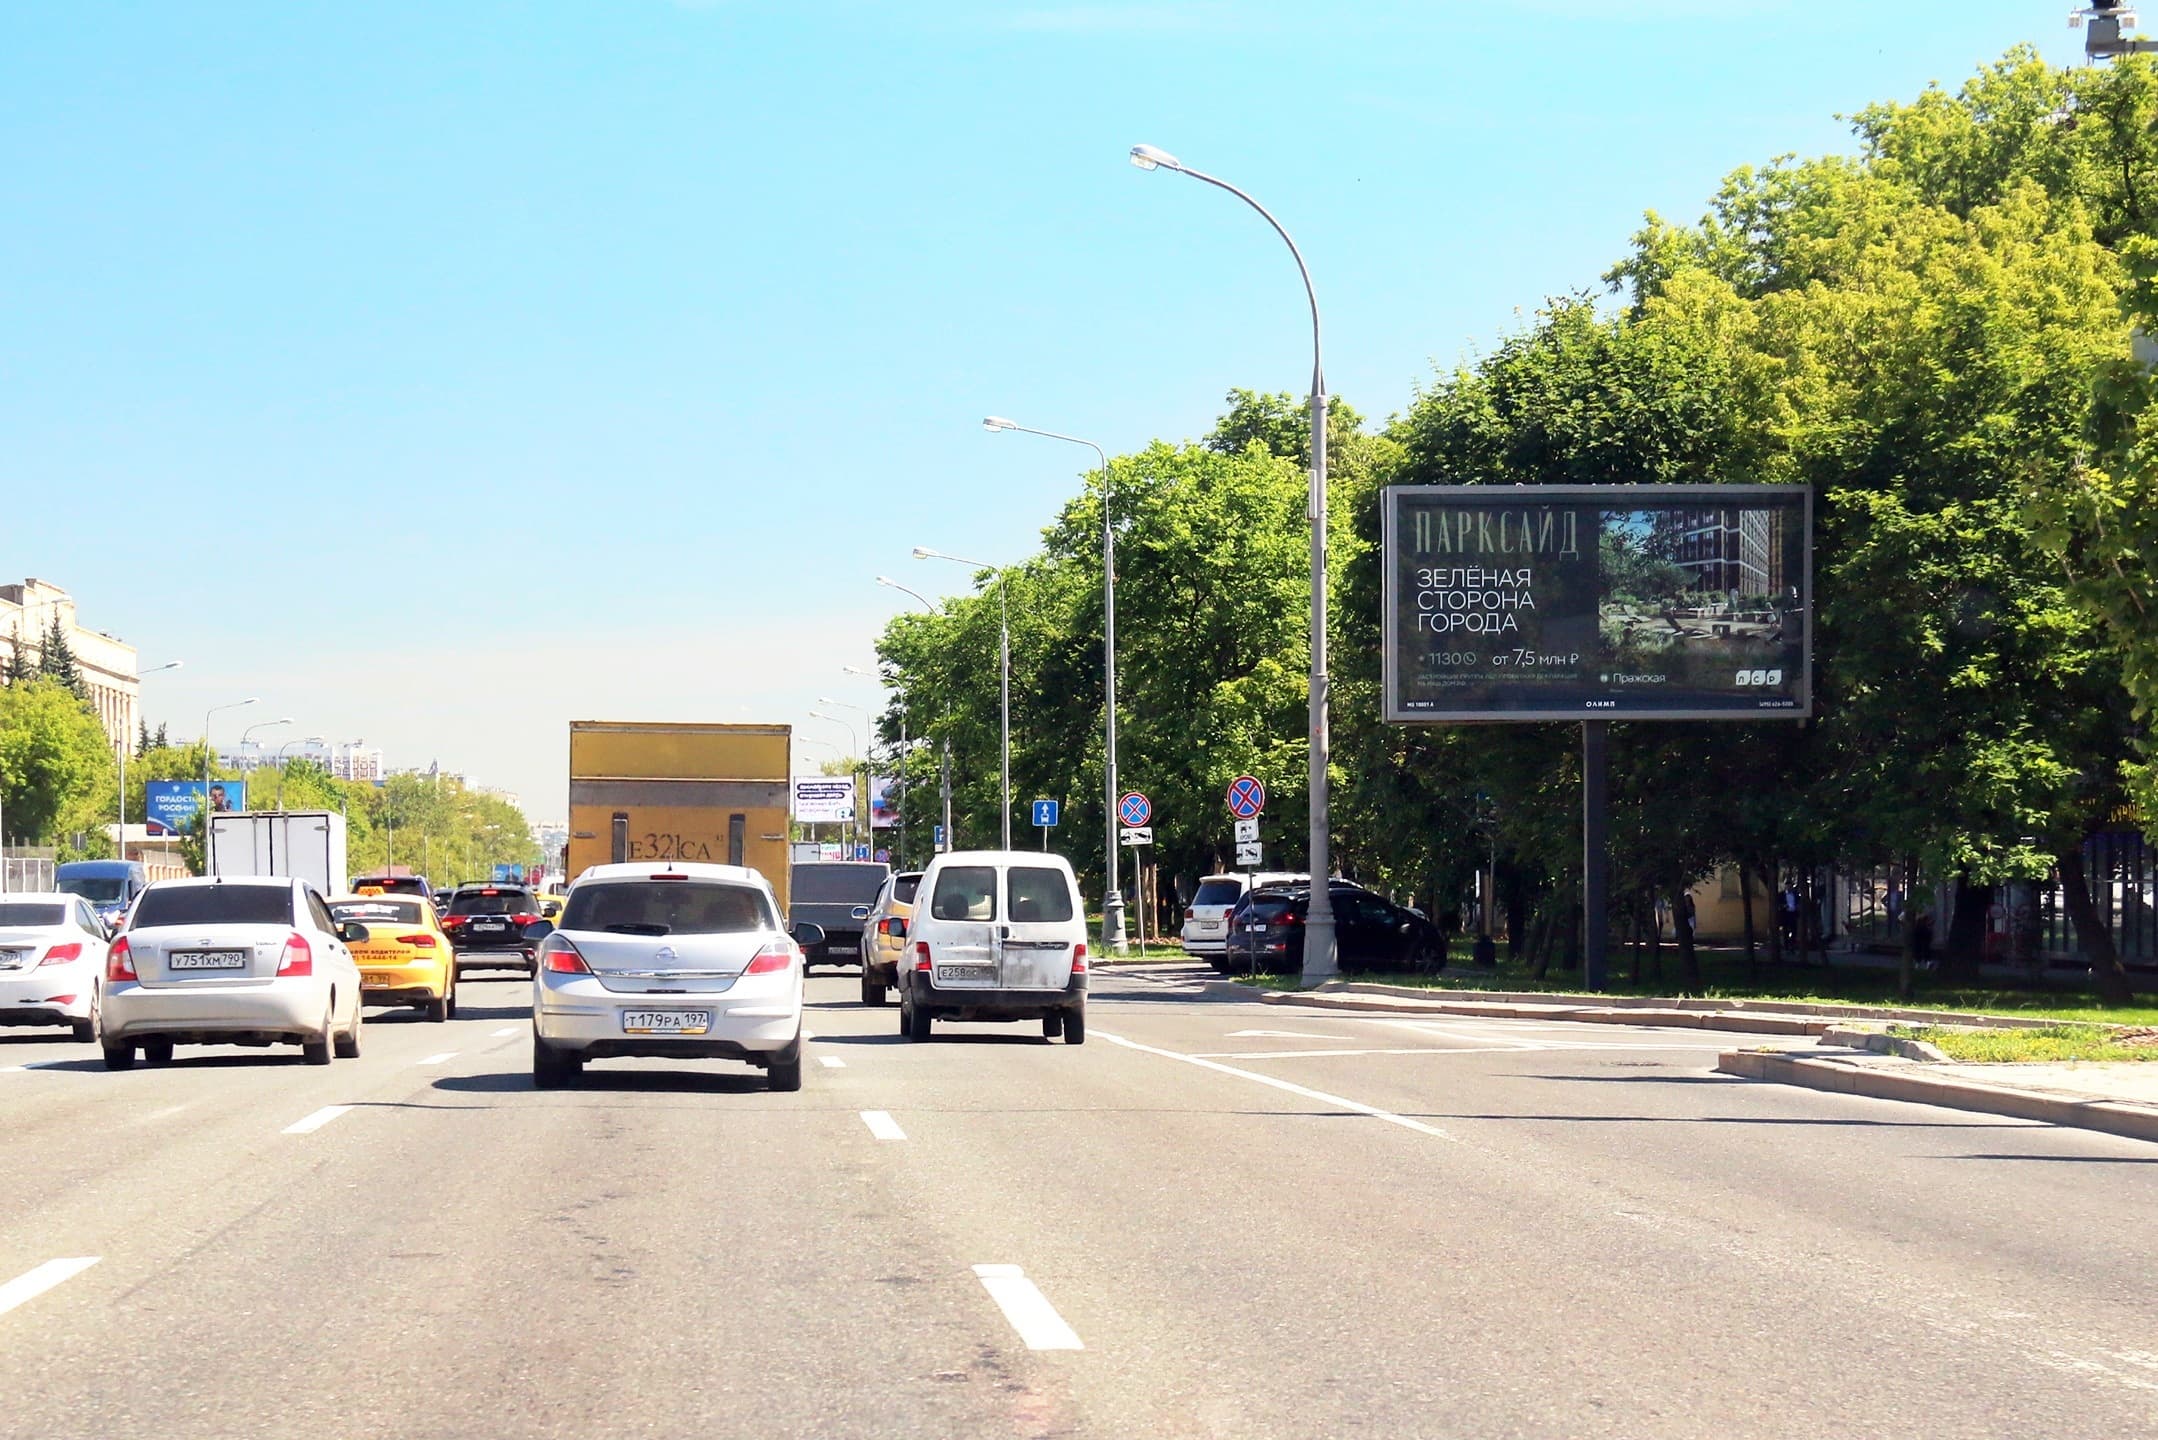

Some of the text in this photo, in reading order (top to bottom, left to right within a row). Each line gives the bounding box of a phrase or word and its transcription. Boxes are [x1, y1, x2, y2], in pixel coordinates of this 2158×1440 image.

[1416, 505, 1579, 560] ПАРКСАЙД
[1417, 565, 1531, 587] ЗЕЛЁНАЯ
[1417, 591, 1535, 610] СТОРОНА
[1418, 613, 1518, 635] ГОРОДА
[1429, 653, 1462, 665] 1130
[1492, 654, 1508, 665] от
[1512, 649, 1535, 667] 7,5
[1539, 655, 1566, 664] млн
[1613, 673, 1666, 684] Пражская
[176, 954, 240, 966] У751ХМ 790
[629, 1014, 704, 1026] Т179РА 197
